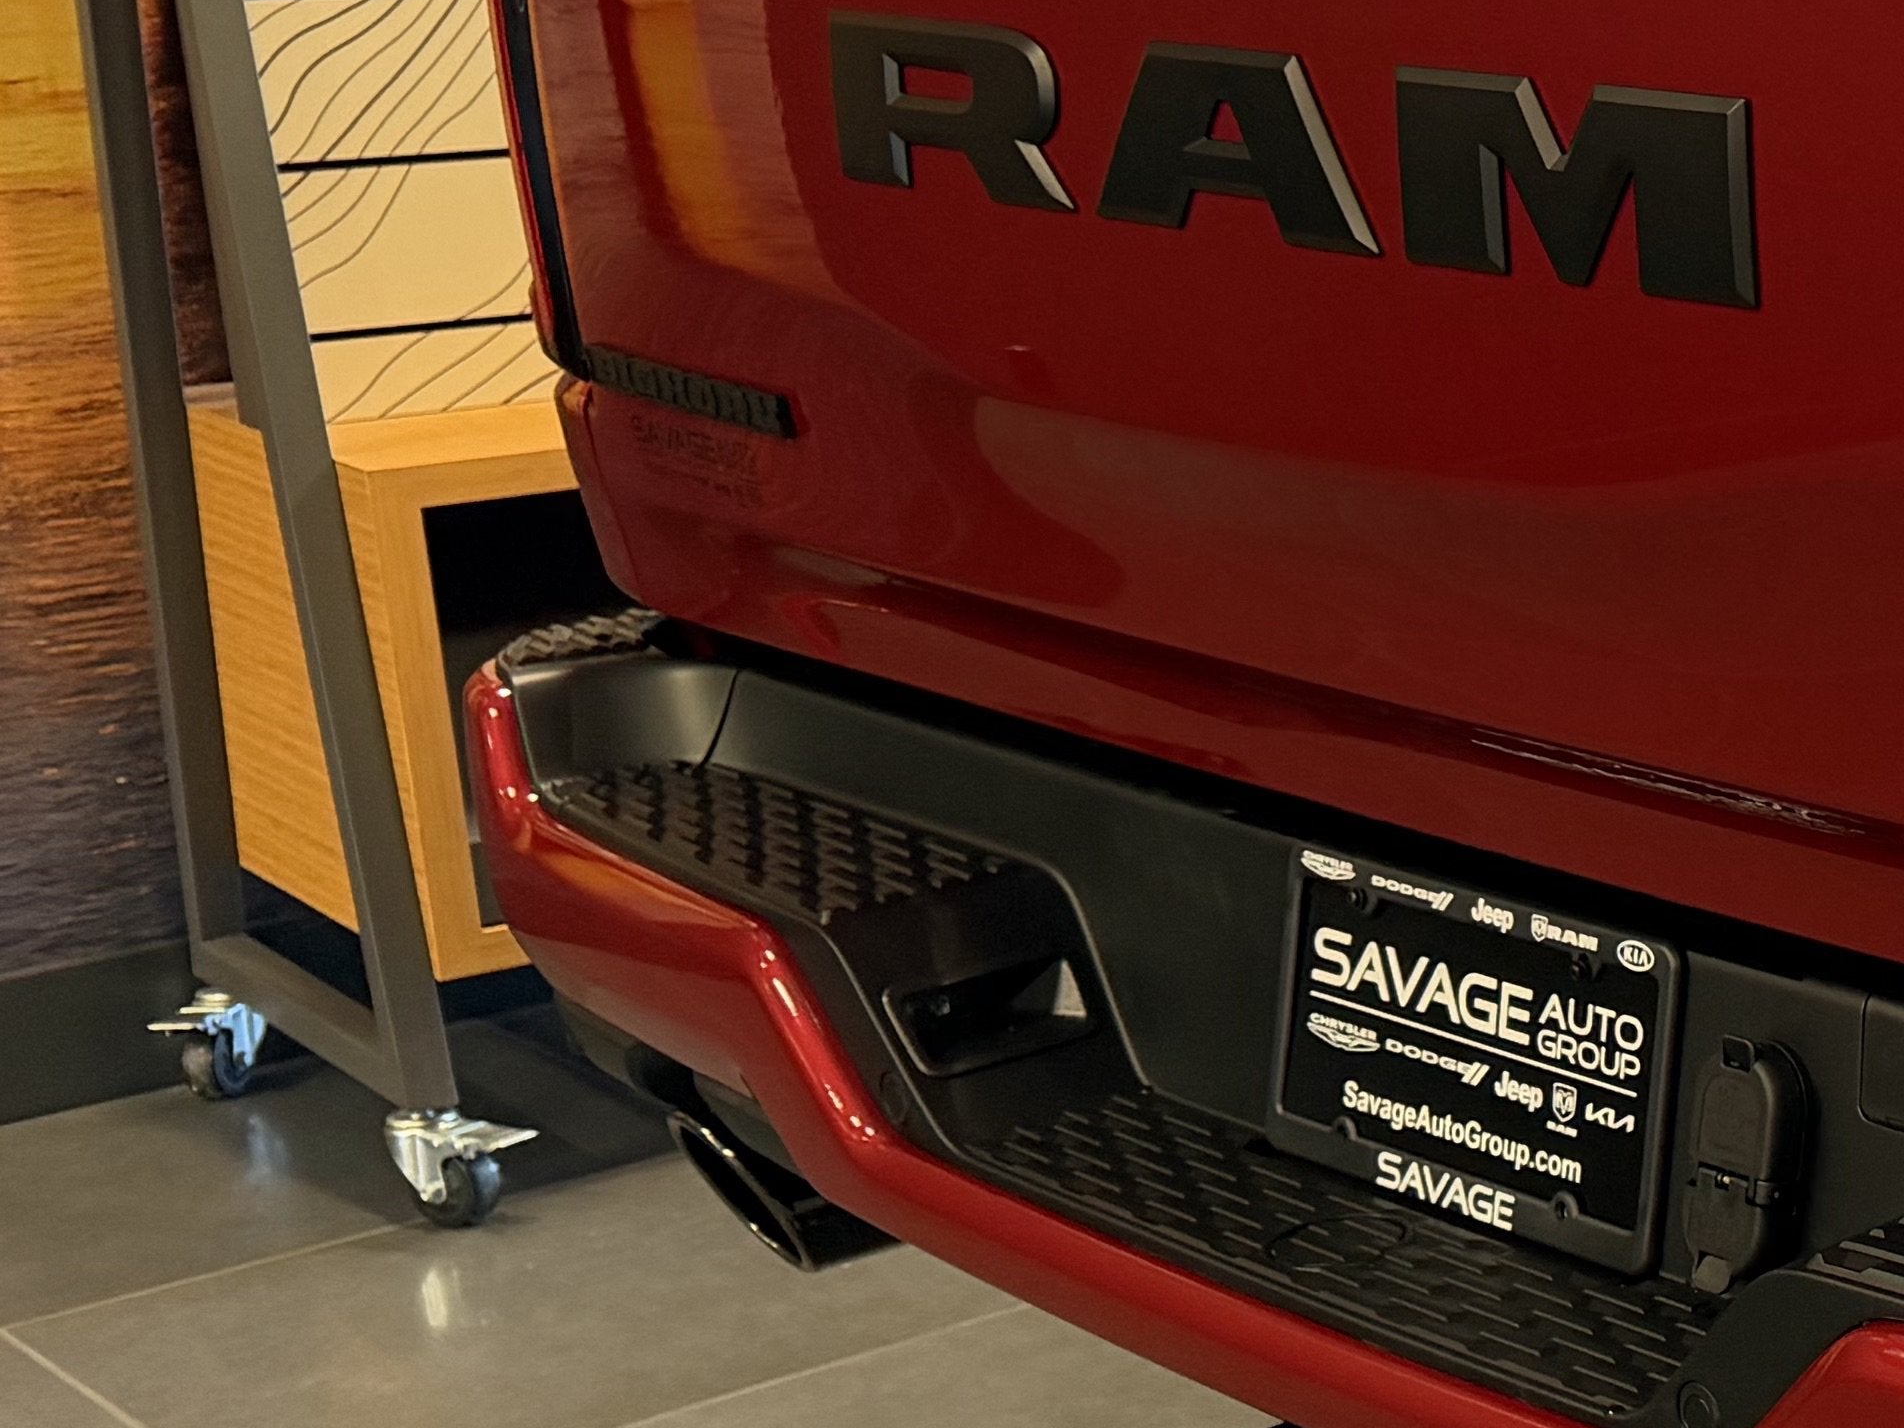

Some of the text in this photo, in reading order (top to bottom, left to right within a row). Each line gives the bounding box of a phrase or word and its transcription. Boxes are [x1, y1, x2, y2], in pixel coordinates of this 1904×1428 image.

[829, 10, 1760, 311] RAM
[1371, 875, 1442, 903] DODGE
[1471, 898, 1514, 933] Jeep
[1548, 925, 1598, 952] RAM
[1620, 944, 1652, 969] KIA
[1310, 926, 1644, 1052] SAVAGE AUTO
[1308, 1011, 1379, 1042] CHRYSLER
[1385, 1037, 1475, 1076] DODGE
[1494, 1071, 1543, 1112] Jeep
[1537, 1029, 1641, 1080] GROUP
[1342, 1080, 1582, 1184] SavageAutoGroup.com
[1375, 1149, 1516, 1232] SAVAGE
